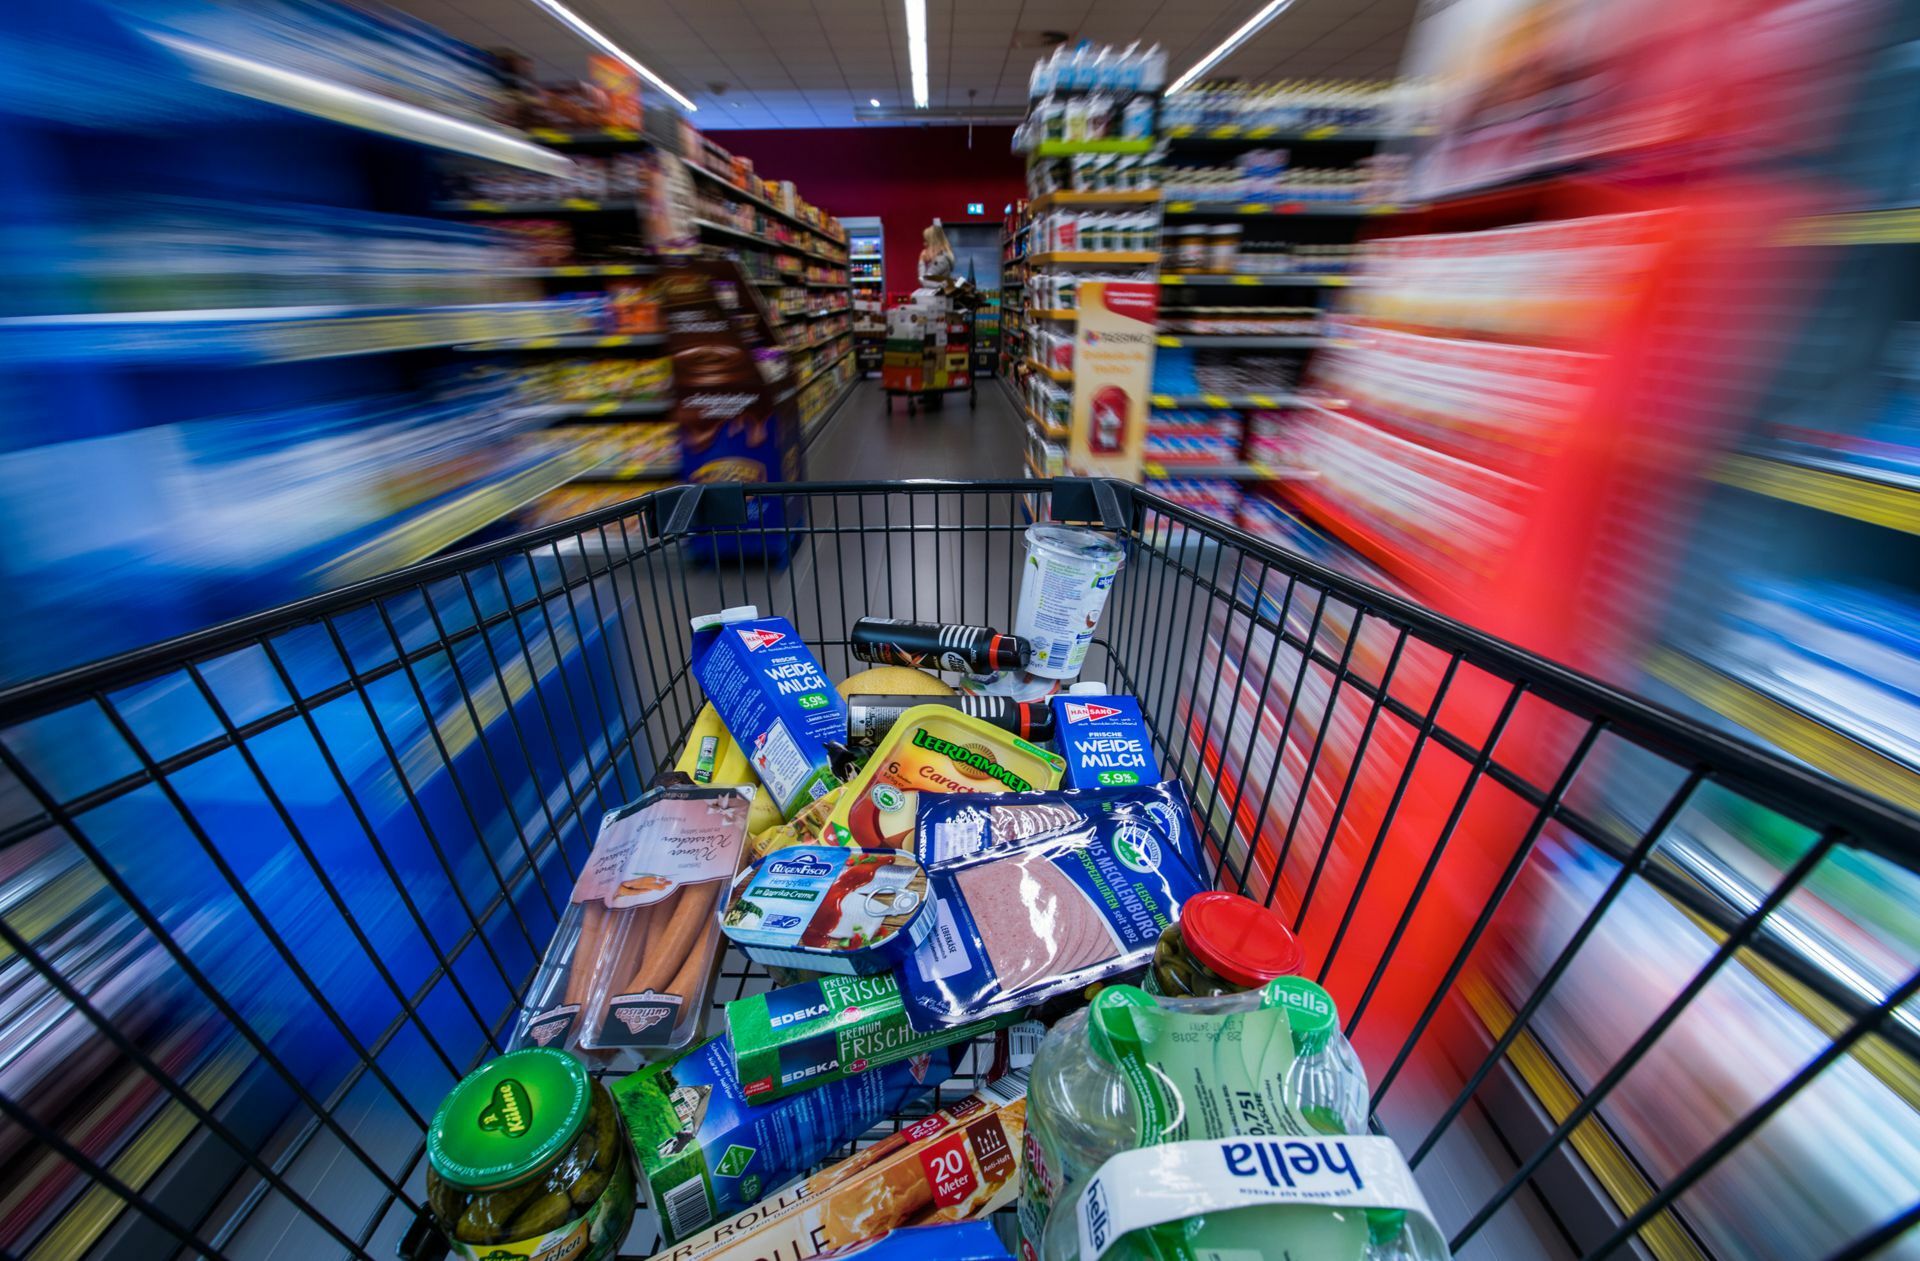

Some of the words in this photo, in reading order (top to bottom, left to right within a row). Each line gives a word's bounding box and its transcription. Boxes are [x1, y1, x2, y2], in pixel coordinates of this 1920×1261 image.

[764, 662, 818, 681] WEIDE
[777, 675, 827, 695] MILCH
[911, 727, 1033, 793] LEERDAMMER
[1074, 739, 1143, 753] WEIDE
[888, 761, 900, 775] 6
[1081, 753, 1146, 768] MILCH
[919, 765, 982, 793] Caract
[668, 846, 719, 861] Wiener
[1096, 857, 1160, 939] MECKLENBURG
[1132, 882, 1159, 914] FLEISCH-
[940, 925, 957, 953] LEBERKÄSE
[1113, 910, 1127, 925] seit
[1122, 924, 1139, 943] 1892
[826, 974, 899, 1010] FRISCH
[1273, 984, 1329, 1015] hella
[615, 1006, 671, 1018] Gutfleisch
[769, 1003, 830, 1028] EDEKA
[839, 1020, 882, 1042] PREMIUM
[841, 1022, 920, 1062] FRISCH
[781, 1059, 840, 1084] EDEKA
[500, 1084, 525, 1133] Kühne
[1253, 1093, 1274, 1135] FLASCHE
[909, 1118, 938, 1136] 20
[930, 1149, 963, 1183] 20
[983, 1153, 1011, 1173] Anti-Haft
[1221, 1141, 1364, 1190] hella
[938, 1174, 969, 1197] Meter
[657, 1183, 814, 1261] R-ROLLE
[1088, 1178, 1107, 1251] hella
